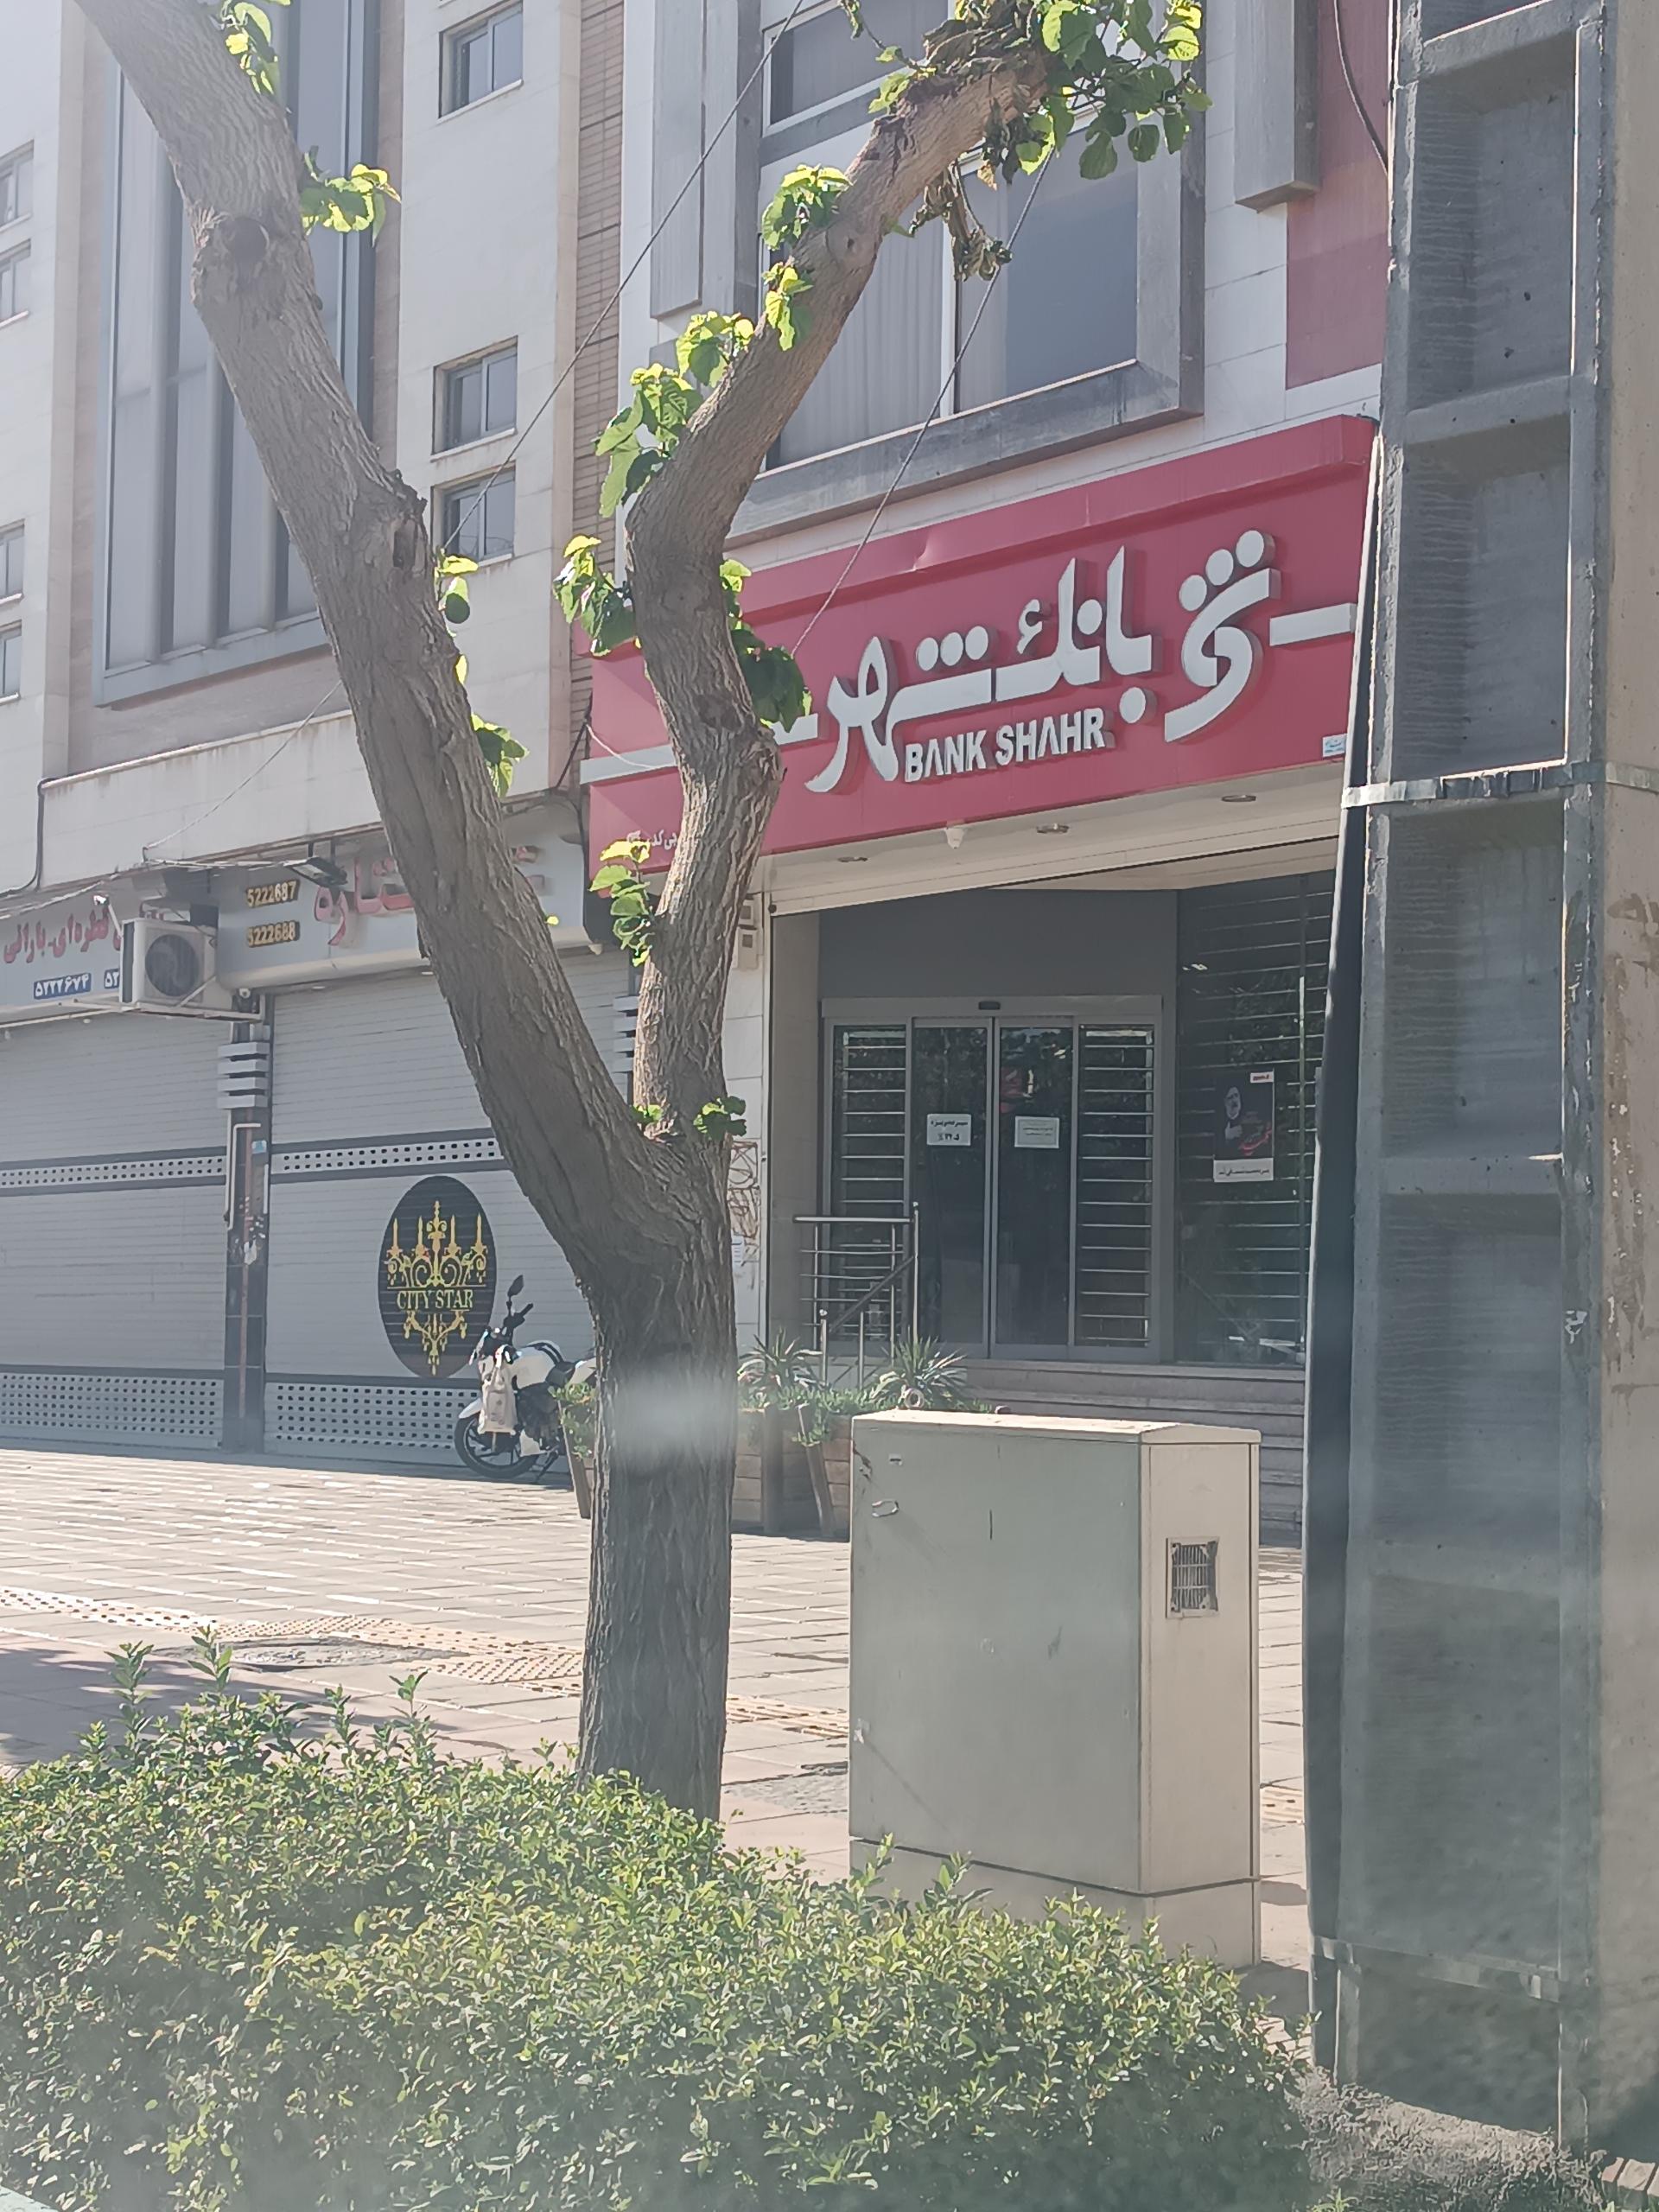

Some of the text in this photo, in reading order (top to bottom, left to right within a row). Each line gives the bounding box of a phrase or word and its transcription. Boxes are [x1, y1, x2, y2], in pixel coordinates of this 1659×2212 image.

[804, 625, 992, 792] شهر
[904, 707, 1106, 783] BANK SHAHR
[246, 880, 297, 908] 5222687
[397, 1287, 474, 1310] CITY STAR
